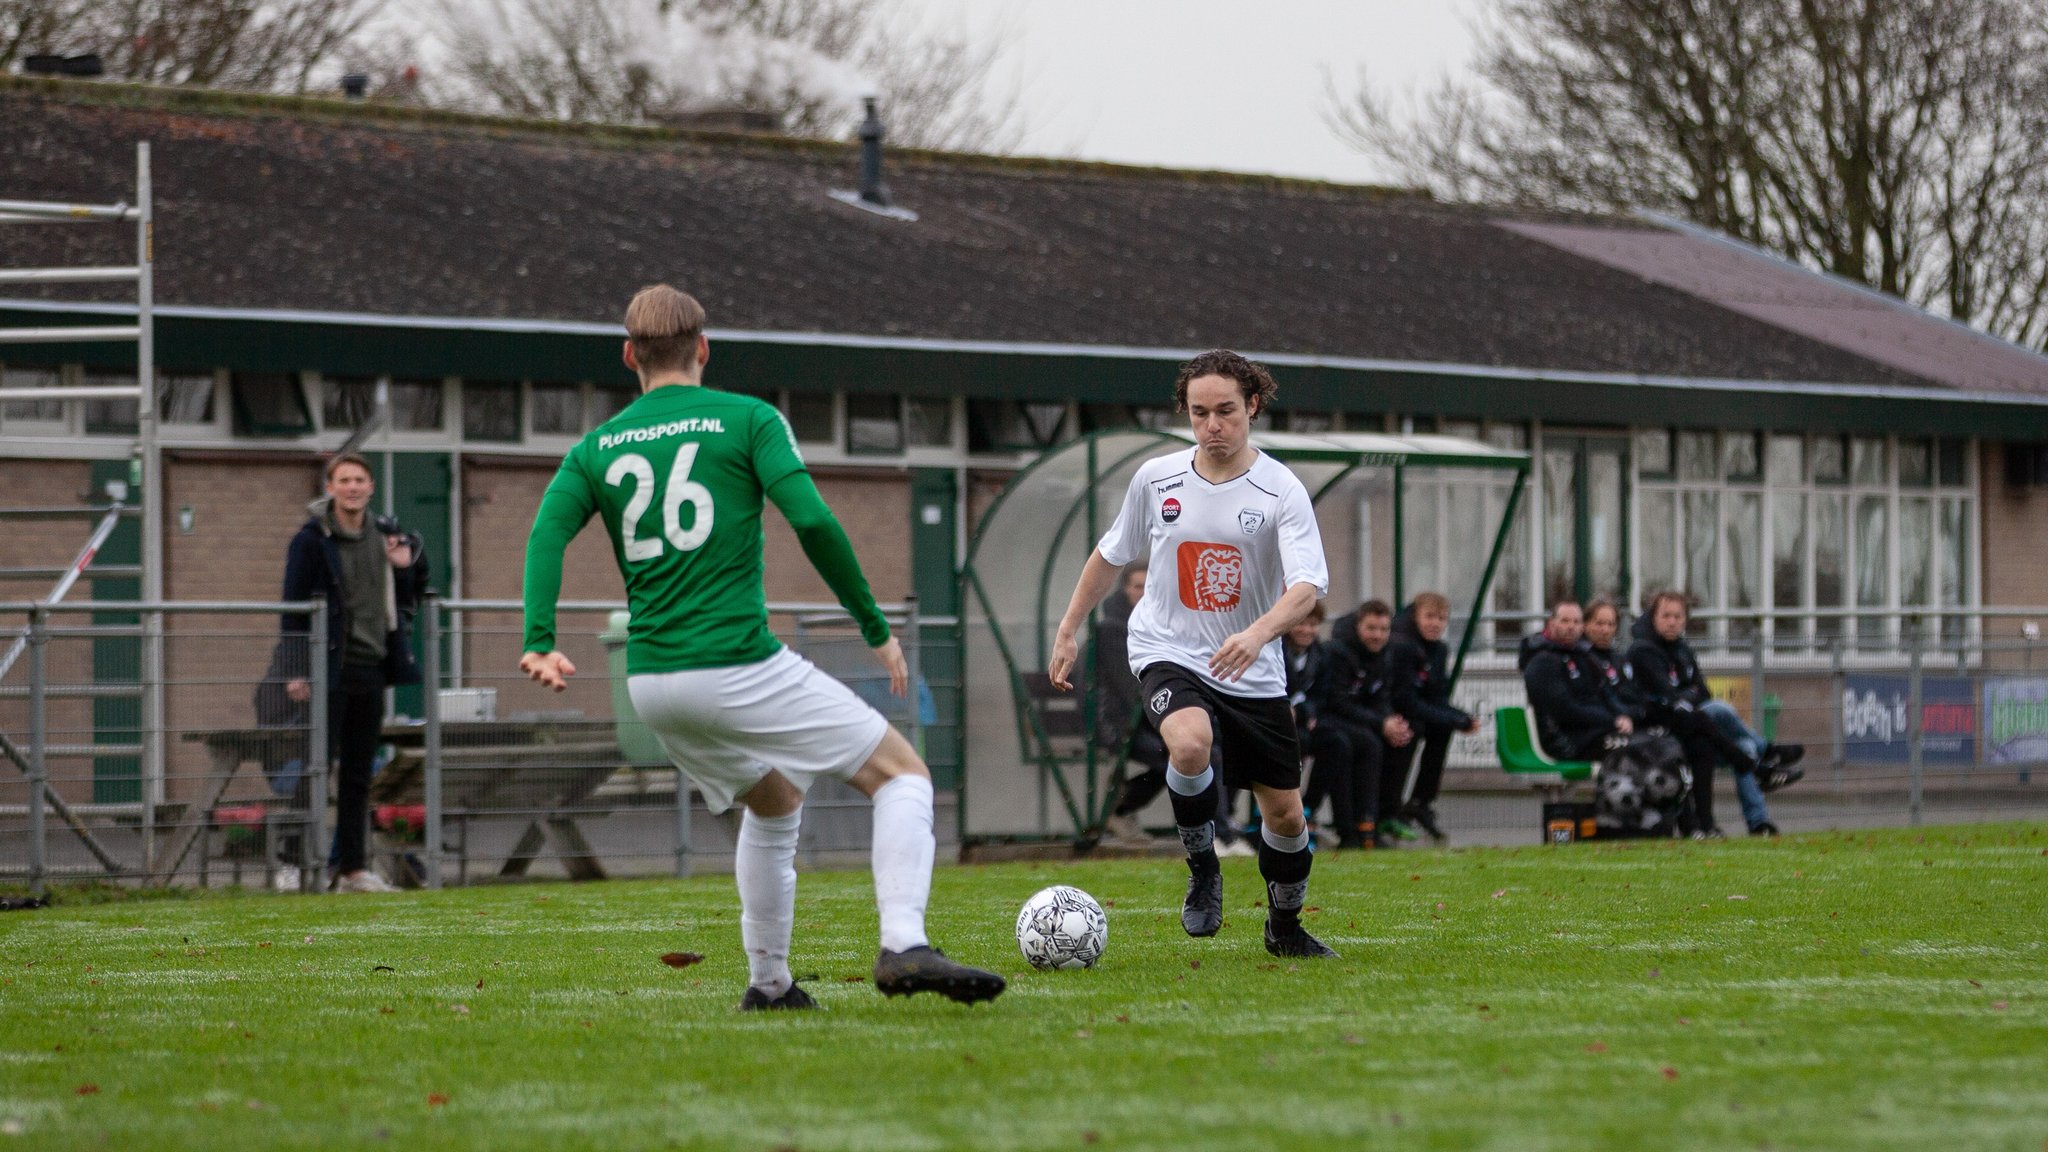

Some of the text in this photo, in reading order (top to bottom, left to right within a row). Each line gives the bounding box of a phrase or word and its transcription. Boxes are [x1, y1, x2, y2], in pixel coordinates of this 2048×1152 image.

[599, 418, 725, 451] PLUTOSPORT.NL
[605, 442, 714, 562] 26
[1157, 479, 1184, 495] hummel
